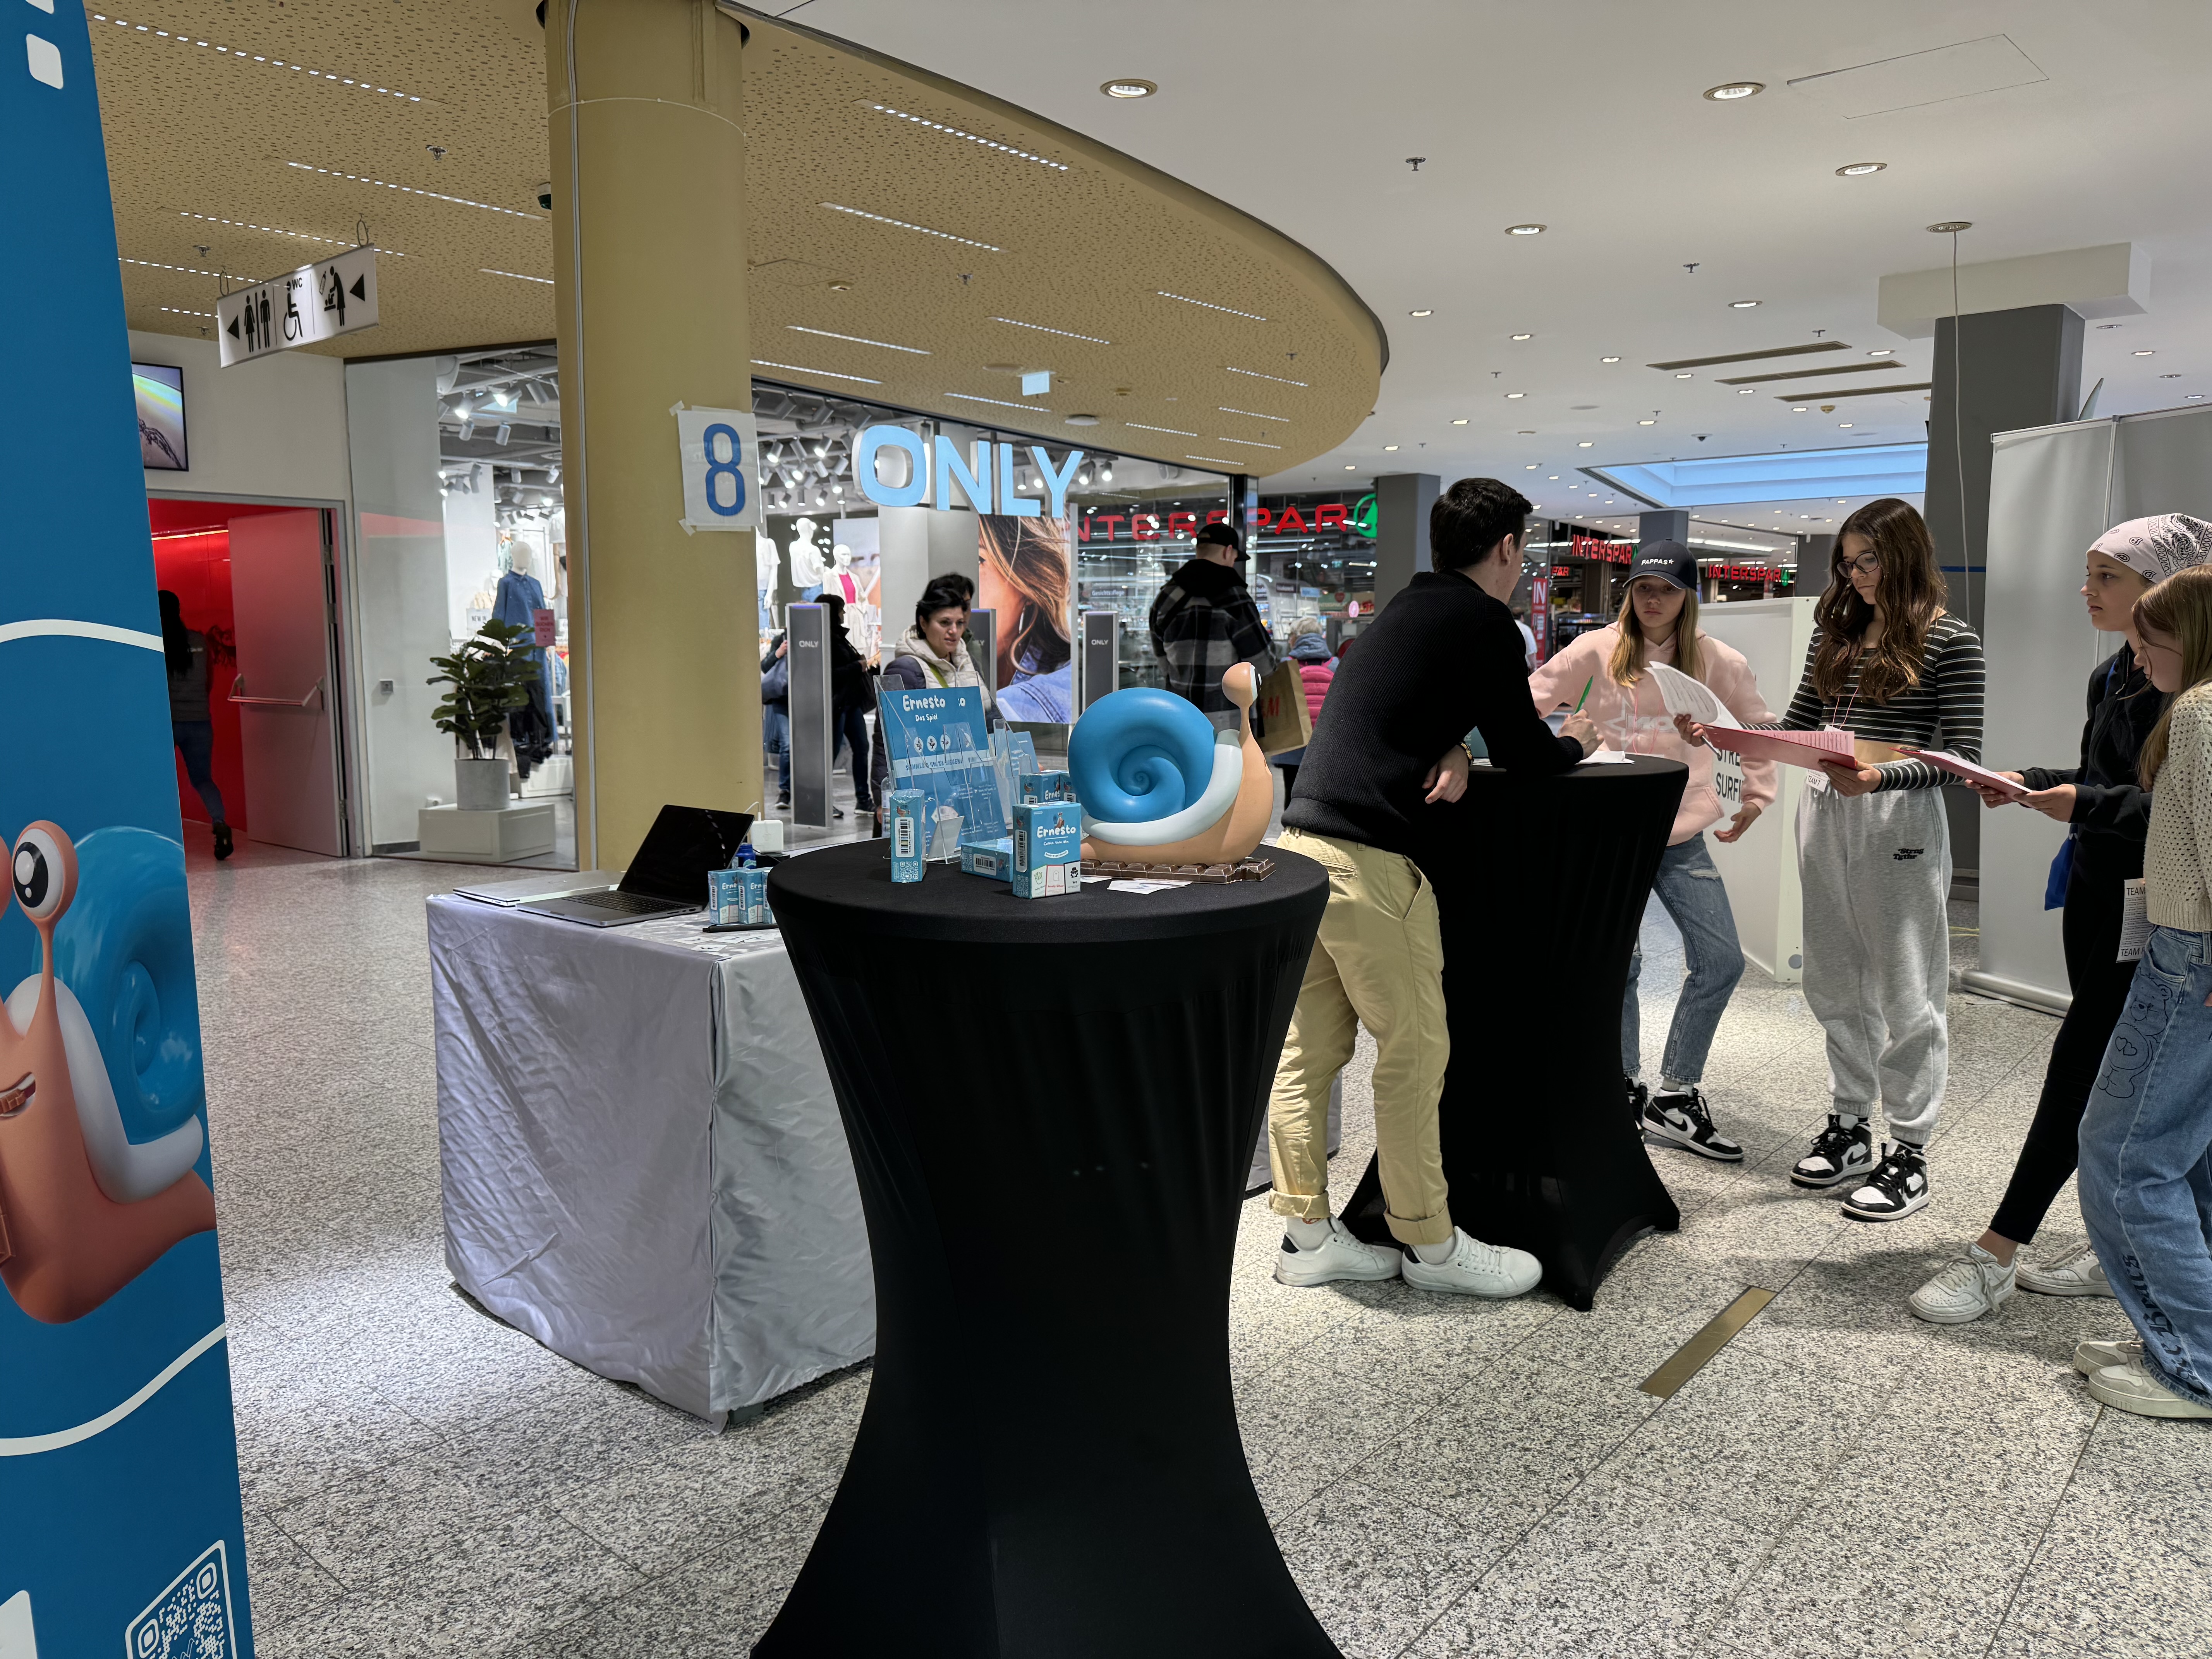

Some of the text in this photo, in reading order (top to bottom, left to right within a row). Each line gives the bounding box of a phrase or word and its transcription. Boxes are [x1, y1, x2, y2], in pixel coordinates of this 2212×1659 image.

[292, 277, 302, 290] WC
[703, 423, 746, 517] 8
[854, 424, 1084, 519] ONLY
[1572, 534, 1632, 565] INTERSPAR
[1708, 564, 1781, 582] INTERSPAR
[902, 695, 946, 711] Ernesto
[926, 713, 938, 722] Spiel
[1045, 790, 1060, 800] Ernes
[1716, 772, 1744, 804] SURFI
[1037, 824, 1076, 838] Ernesto
[2126, 886, 2146, 896] TEAM
[2121, 948, 2140, 957] TEAM
